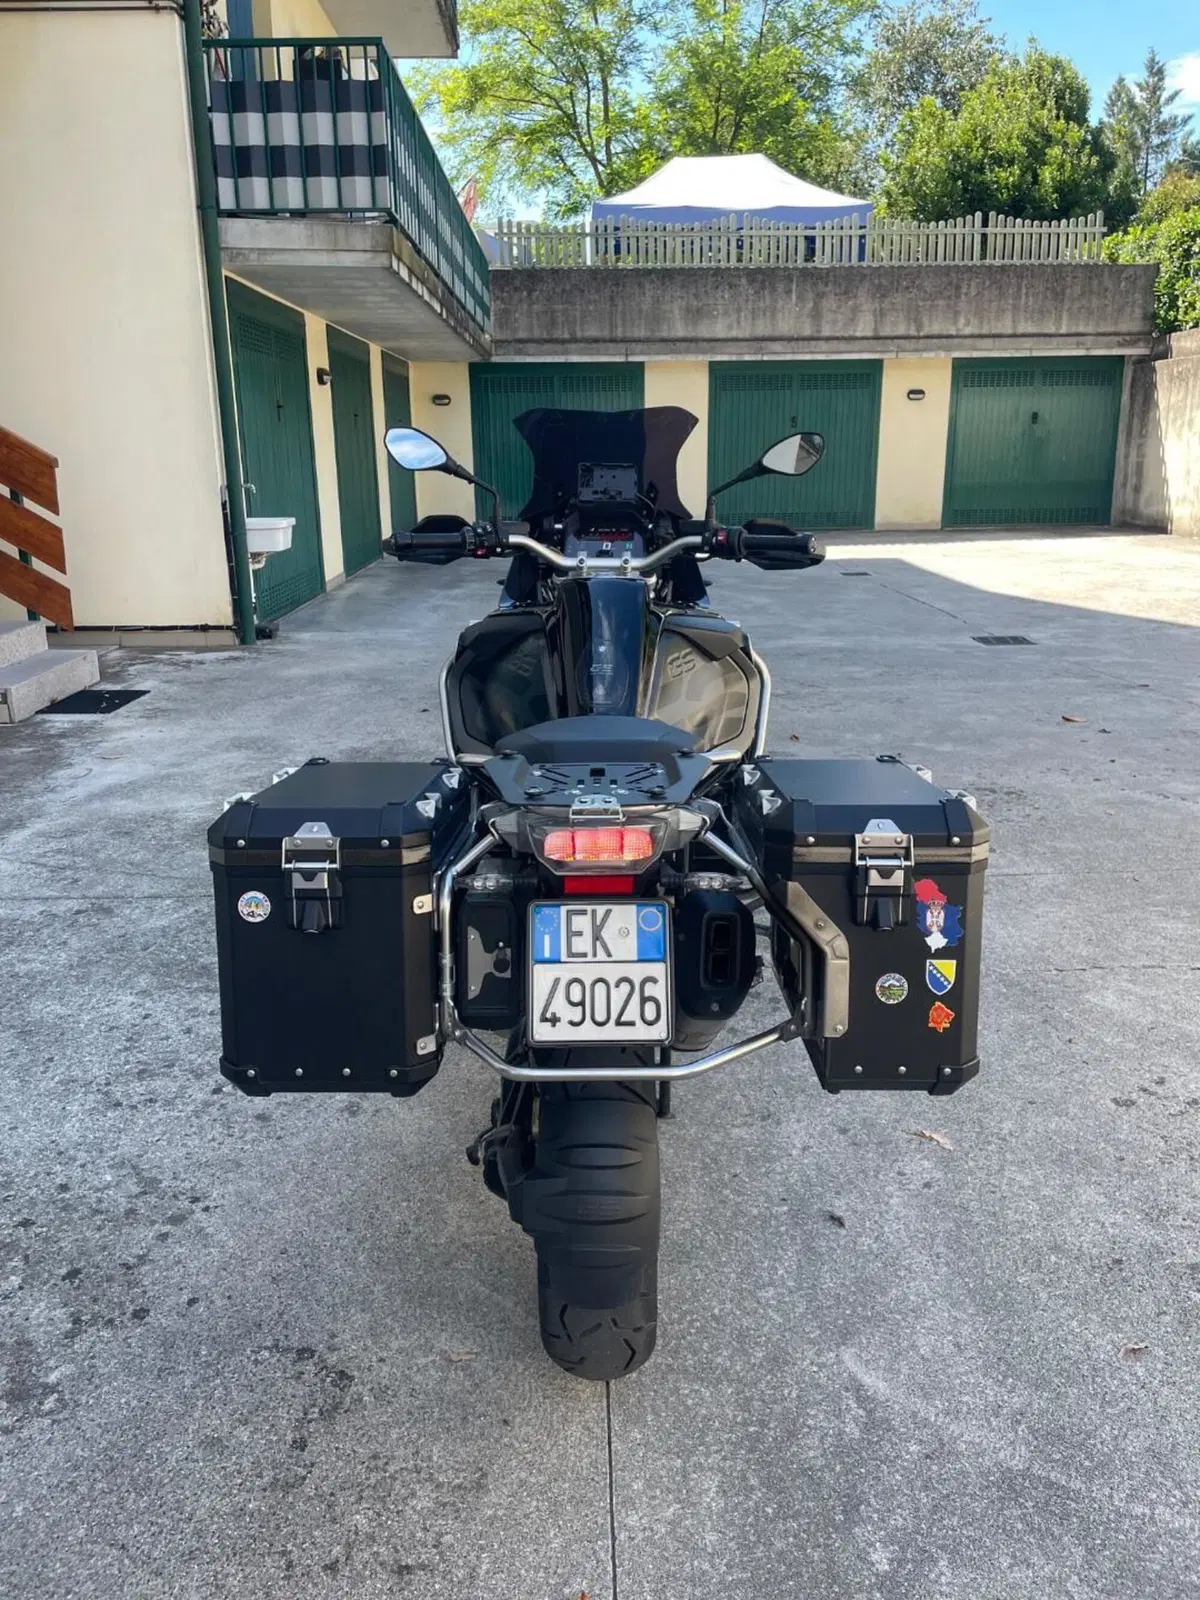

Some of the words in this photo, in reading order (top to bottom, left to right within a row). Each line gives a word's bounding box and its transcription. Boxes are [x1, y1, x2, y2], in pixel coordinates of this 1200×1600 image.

[668, 648, 695, 679] GS
[566, 909, 613, 958] EK
[539, 976, 662, 1028] 49026
